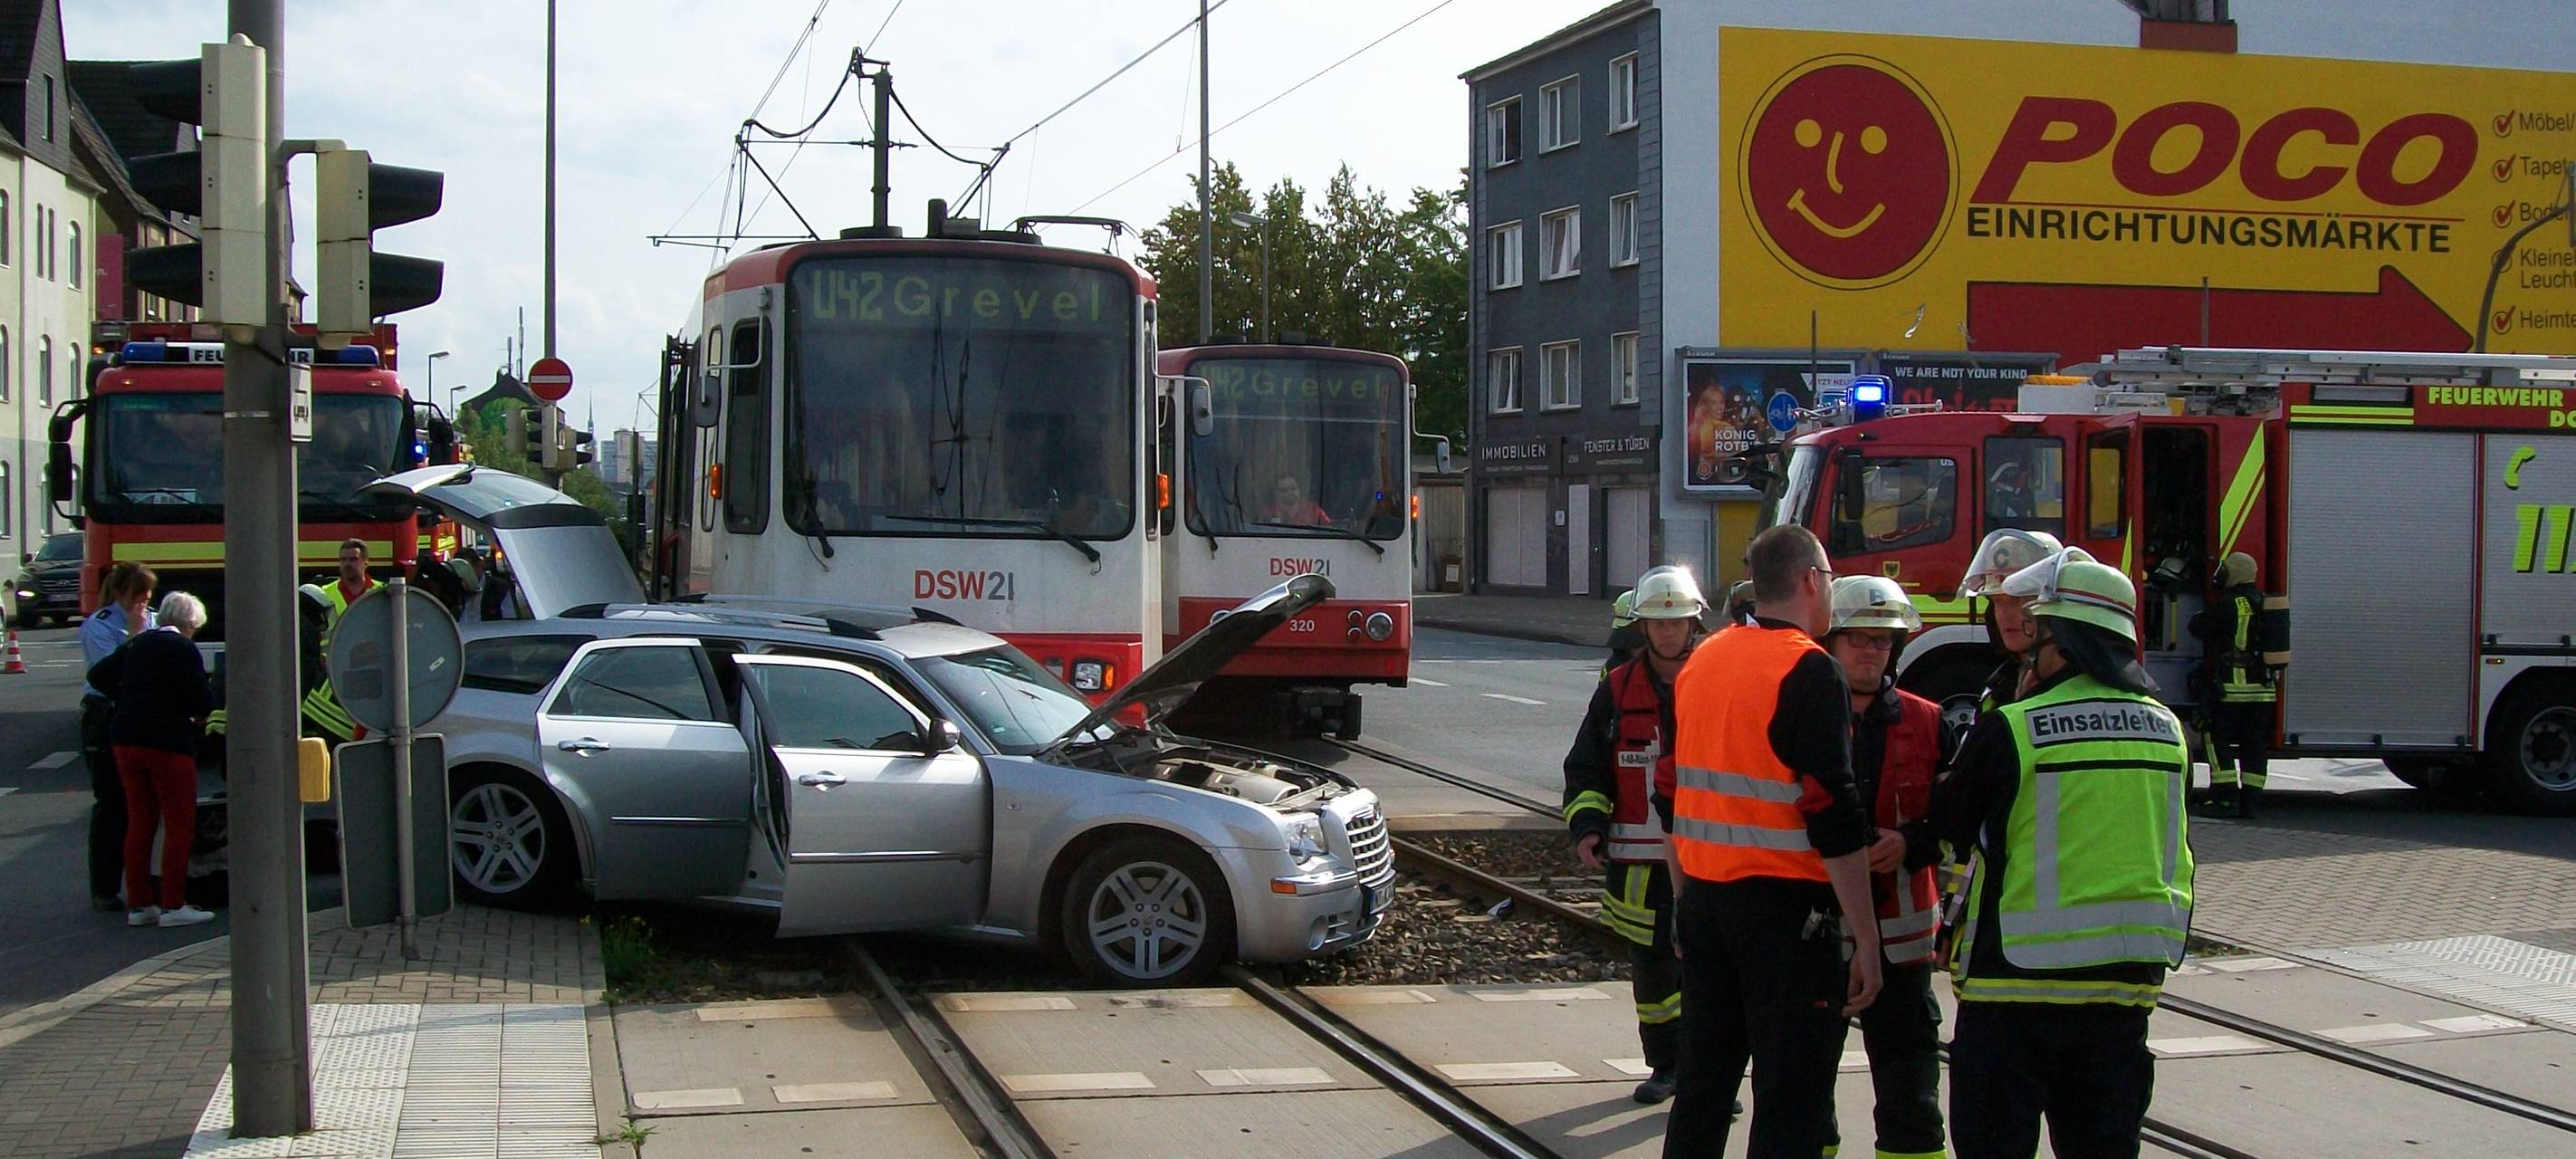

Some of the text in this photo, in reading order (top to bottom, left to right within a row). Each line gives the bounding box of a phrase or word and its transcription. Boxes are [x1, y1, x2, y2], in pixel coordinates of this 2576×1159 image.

[1969, 96, 2479, 206] POCO
[2520, 156, 2573, 180] Tapet
[1968, 207, 2451, 254] EINRICHTUNGSMÄRKTE
[2520, 247, 2576, 267] Kleine
[814, 270, 1100, 321] U42 Grevel
[1895, 366, 2028, 379] WE ARE NOT YOUR KIND
[1250, 369, 1383, 399] Grevel
[2428, 387, 2564, 407] FEUERWEHR
[1715, 426, 1756, 440] KÖNIG
[1481, 444, 1547, 460] IMMOBILIEN
[1585, 436, 1651, 453] FENSTER & TÜREN
[2513, 503, 2576, 572] 11
[1269, 558, 1331, 577] DSW21
[915, 570, 1014, 600] DSW21
[1289, 619, 1315, 631] 320
[2032, 708, 2175, 737] Einsatzleiter
